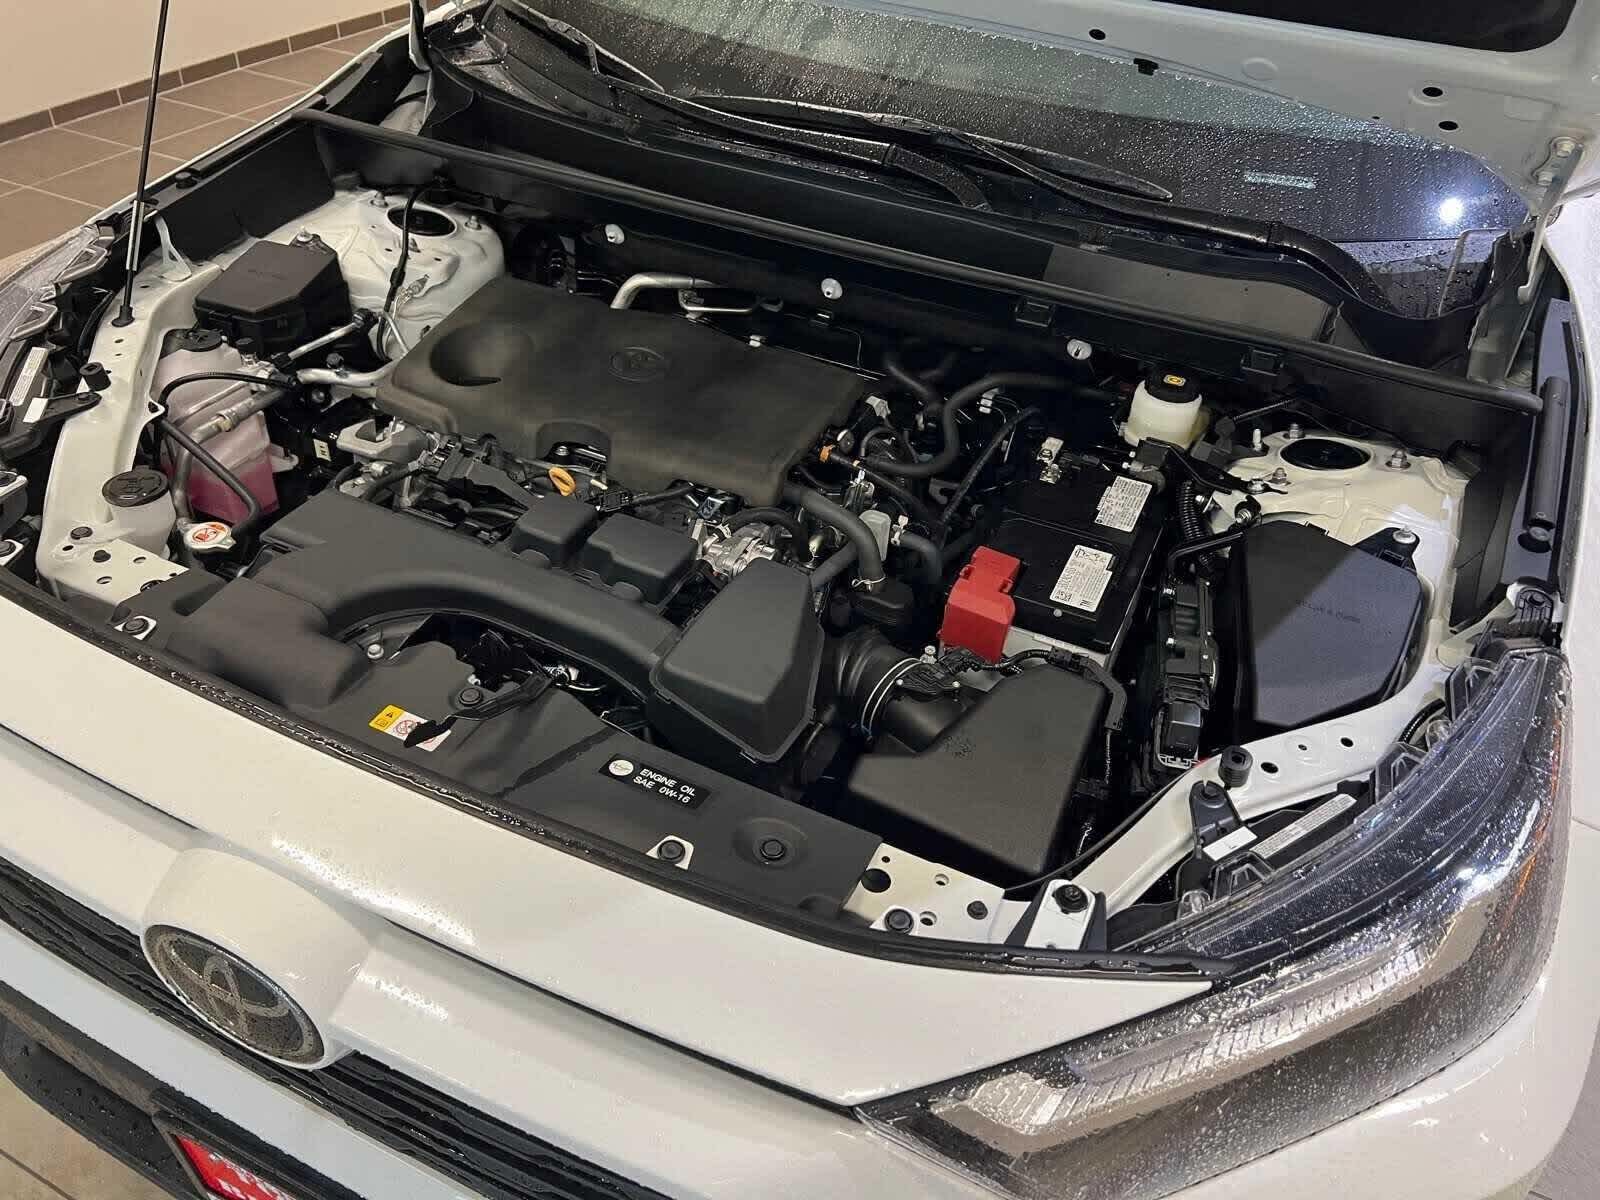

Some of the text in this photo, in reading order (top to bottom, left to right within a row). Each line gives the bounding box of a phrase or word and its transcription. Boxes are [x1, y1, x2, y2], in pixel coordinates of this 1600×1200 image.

[633, 776, 691, 803] SAE 0W-16
[640, 768, 696, 796] ENGINE OIL
